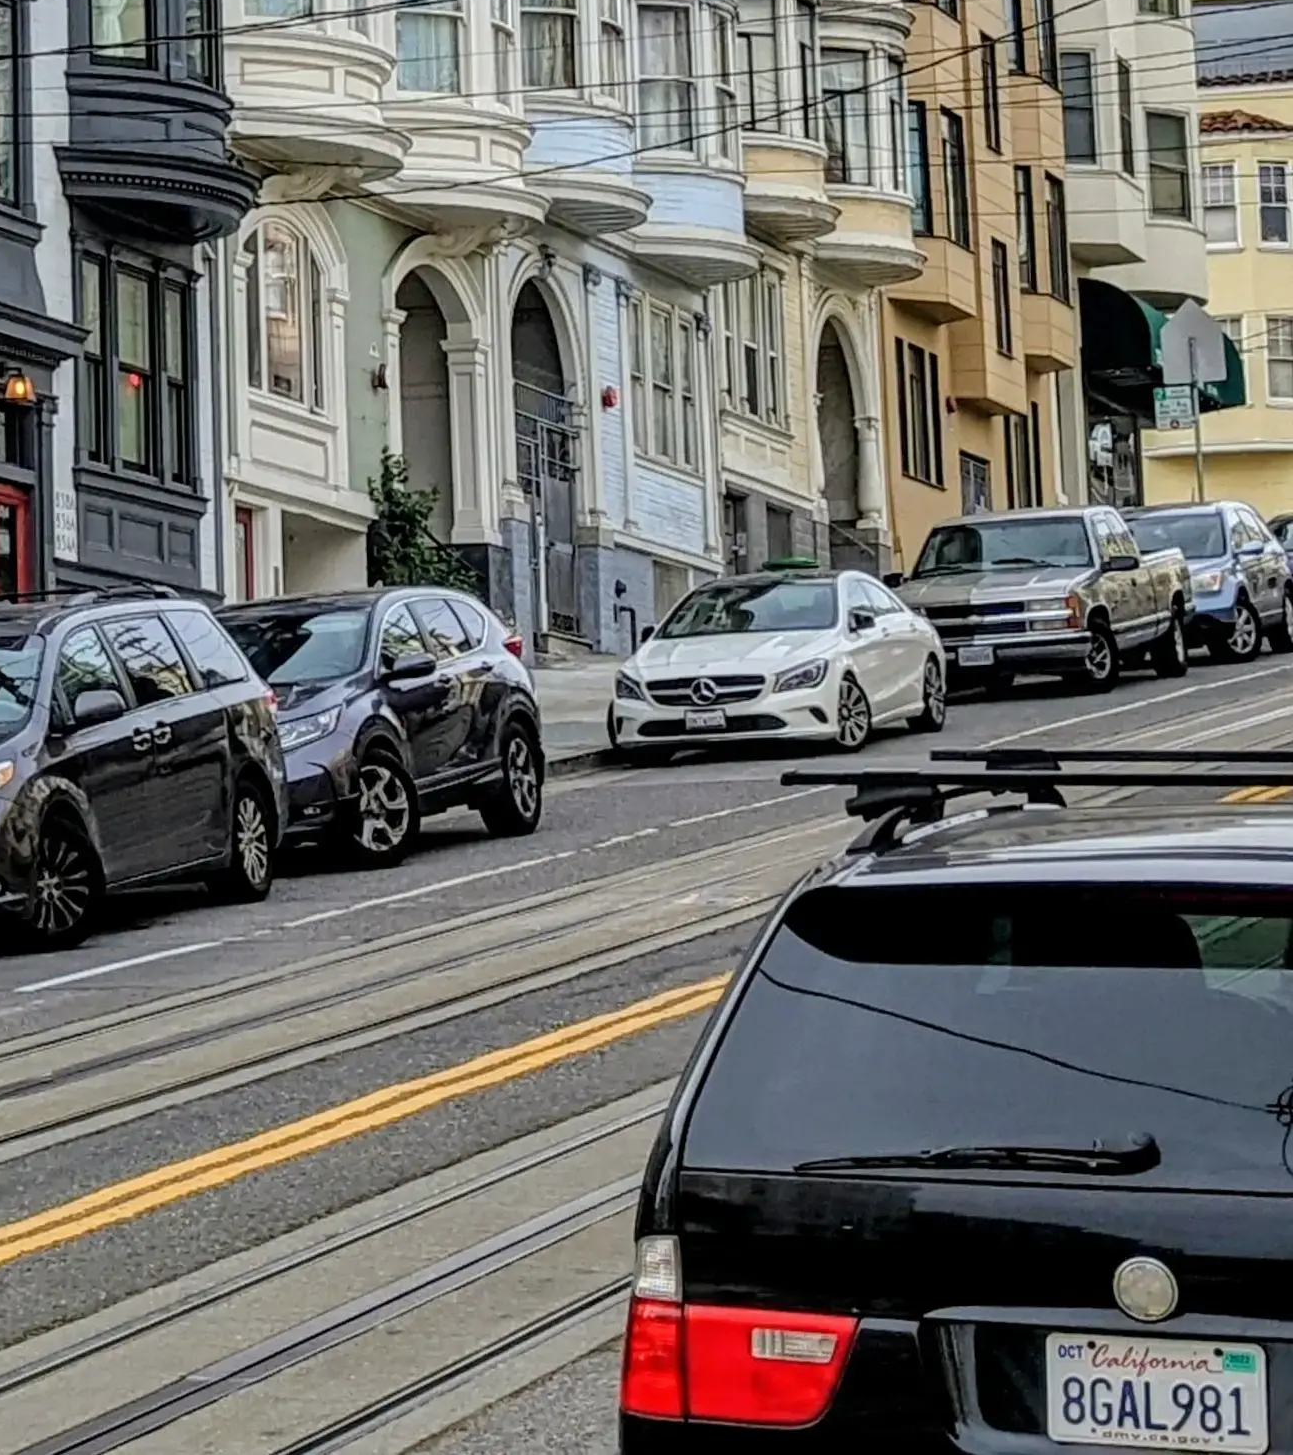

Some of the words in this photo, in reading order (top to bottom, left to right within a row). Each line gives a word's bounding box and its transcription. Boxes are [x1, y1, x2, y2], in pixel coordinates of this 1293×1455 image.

[1058, 1344, 1084, 1359] OCT
[1090, 1343, 1225, 1378] California
[1062, 1376, 1251, 1437] 8GAL981
[1101, 1429, 1213, 1445] dmv.ca.gov
